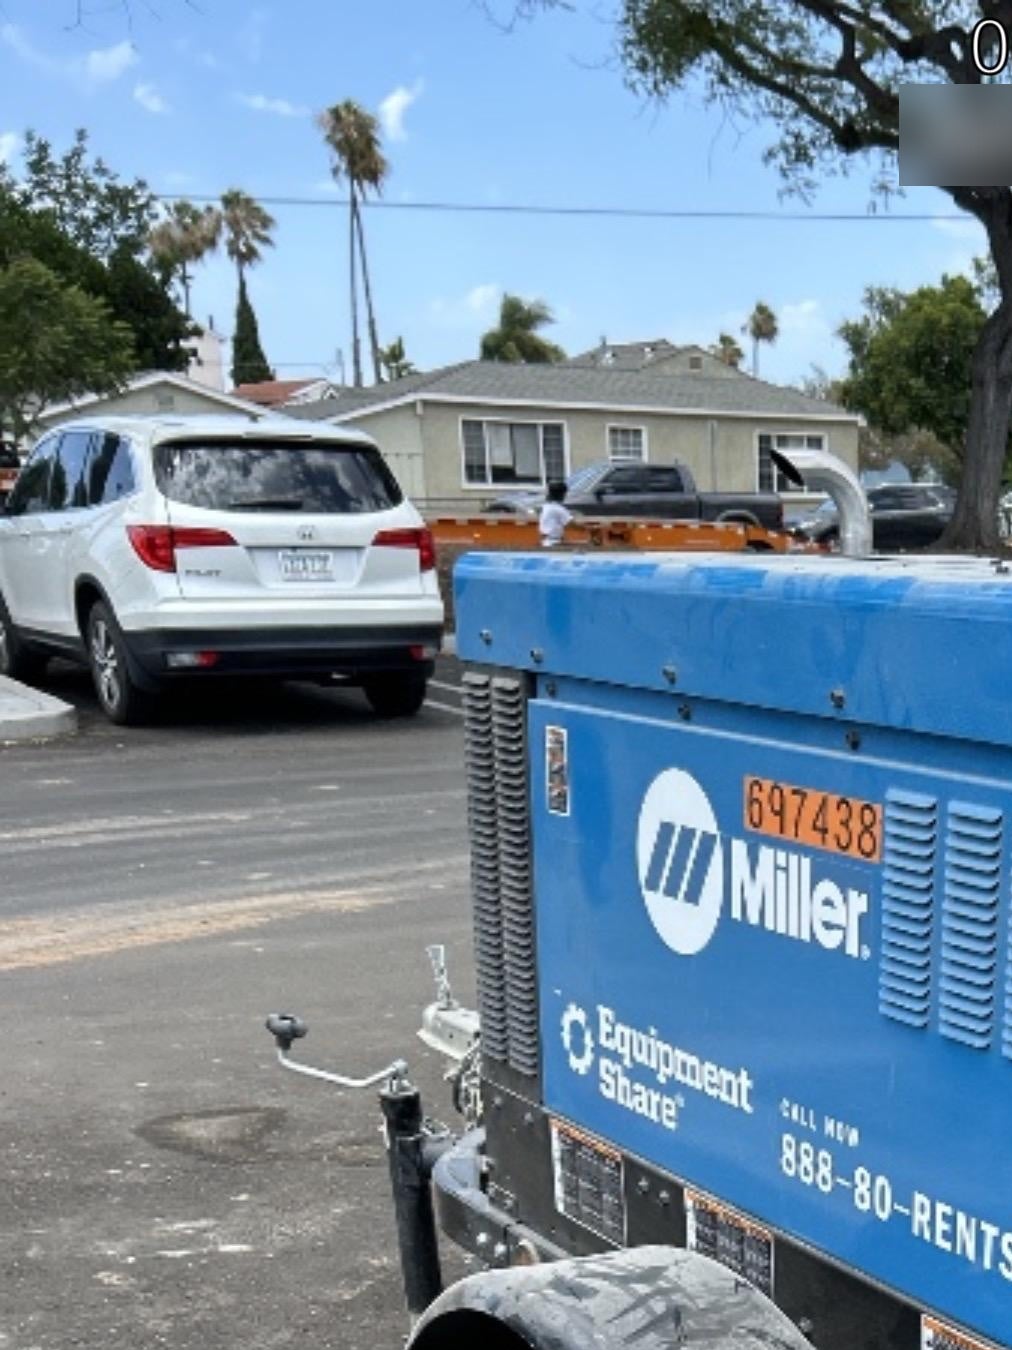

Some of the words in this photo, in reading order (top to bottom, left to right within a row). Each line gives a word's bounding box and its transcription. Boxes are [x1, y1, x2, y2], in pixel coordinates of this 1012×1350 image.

[747, 779, 879, 859] 697438
[730, 838, 868, 957] Miller
[596, 1004, 754, 1114] Equipment
[598, 1057, 677, 1131] Share
[779, 1097, 817, 1133] CALL
[823, 1114, 860, 1148] NOW
